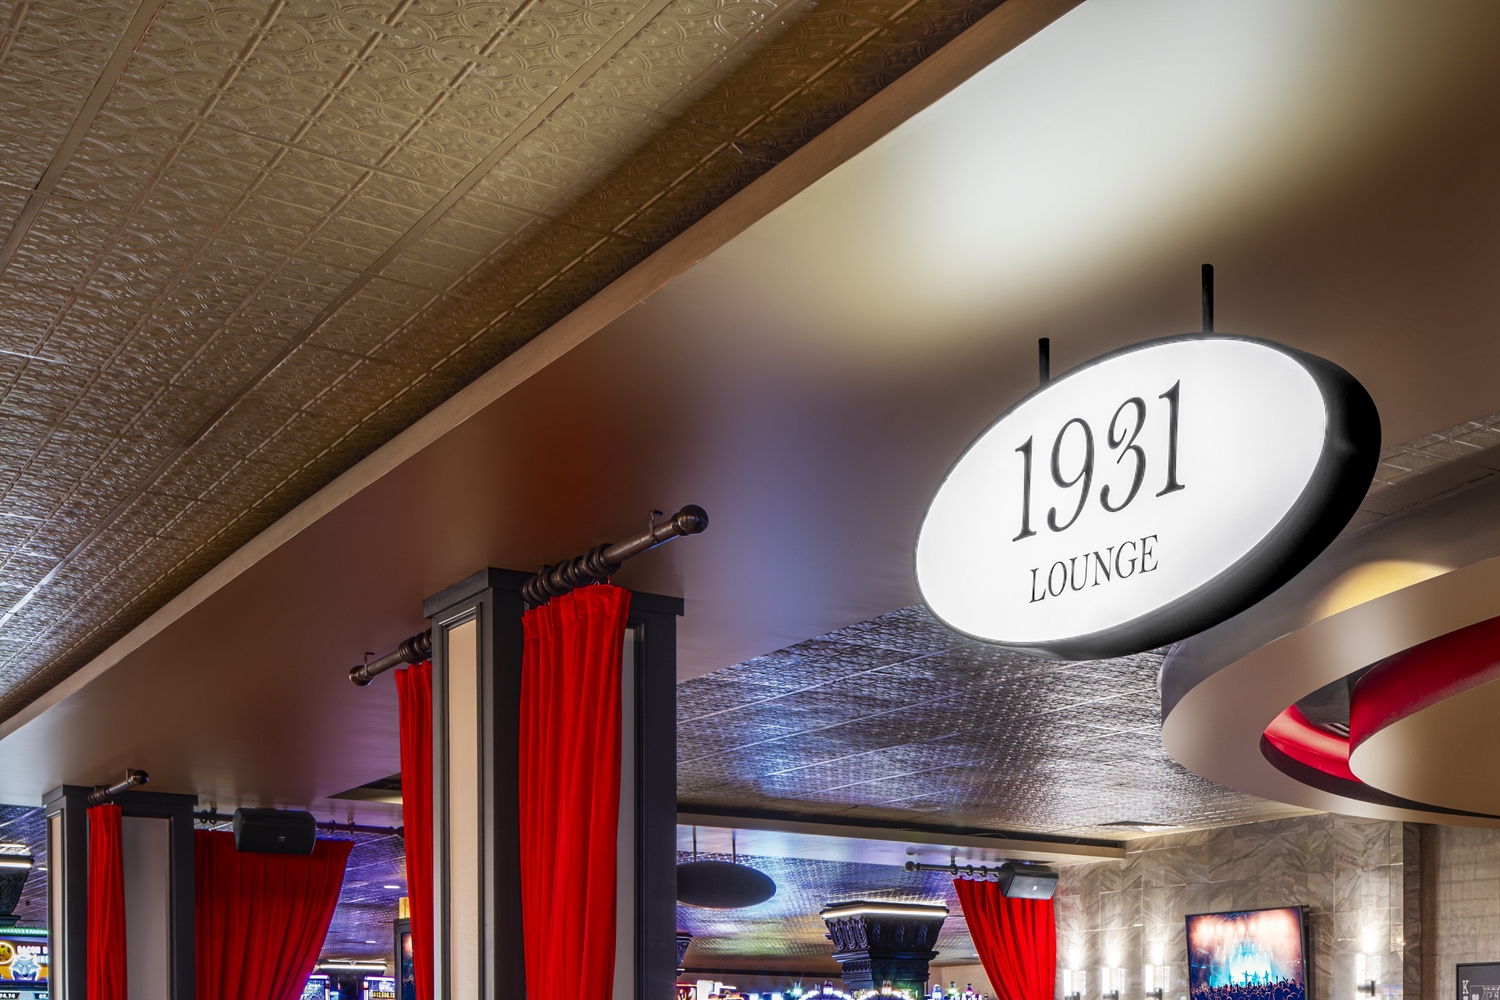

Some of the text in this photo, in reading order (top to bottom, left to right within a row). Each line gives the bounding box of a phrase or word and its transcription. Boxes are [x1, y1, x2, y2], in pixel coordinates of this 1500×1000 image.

[1012, 379, 1186, 543] 1931
[1029, 534, 1159, 604] LOUNGE
[1462, 980, 1470, 994] K
